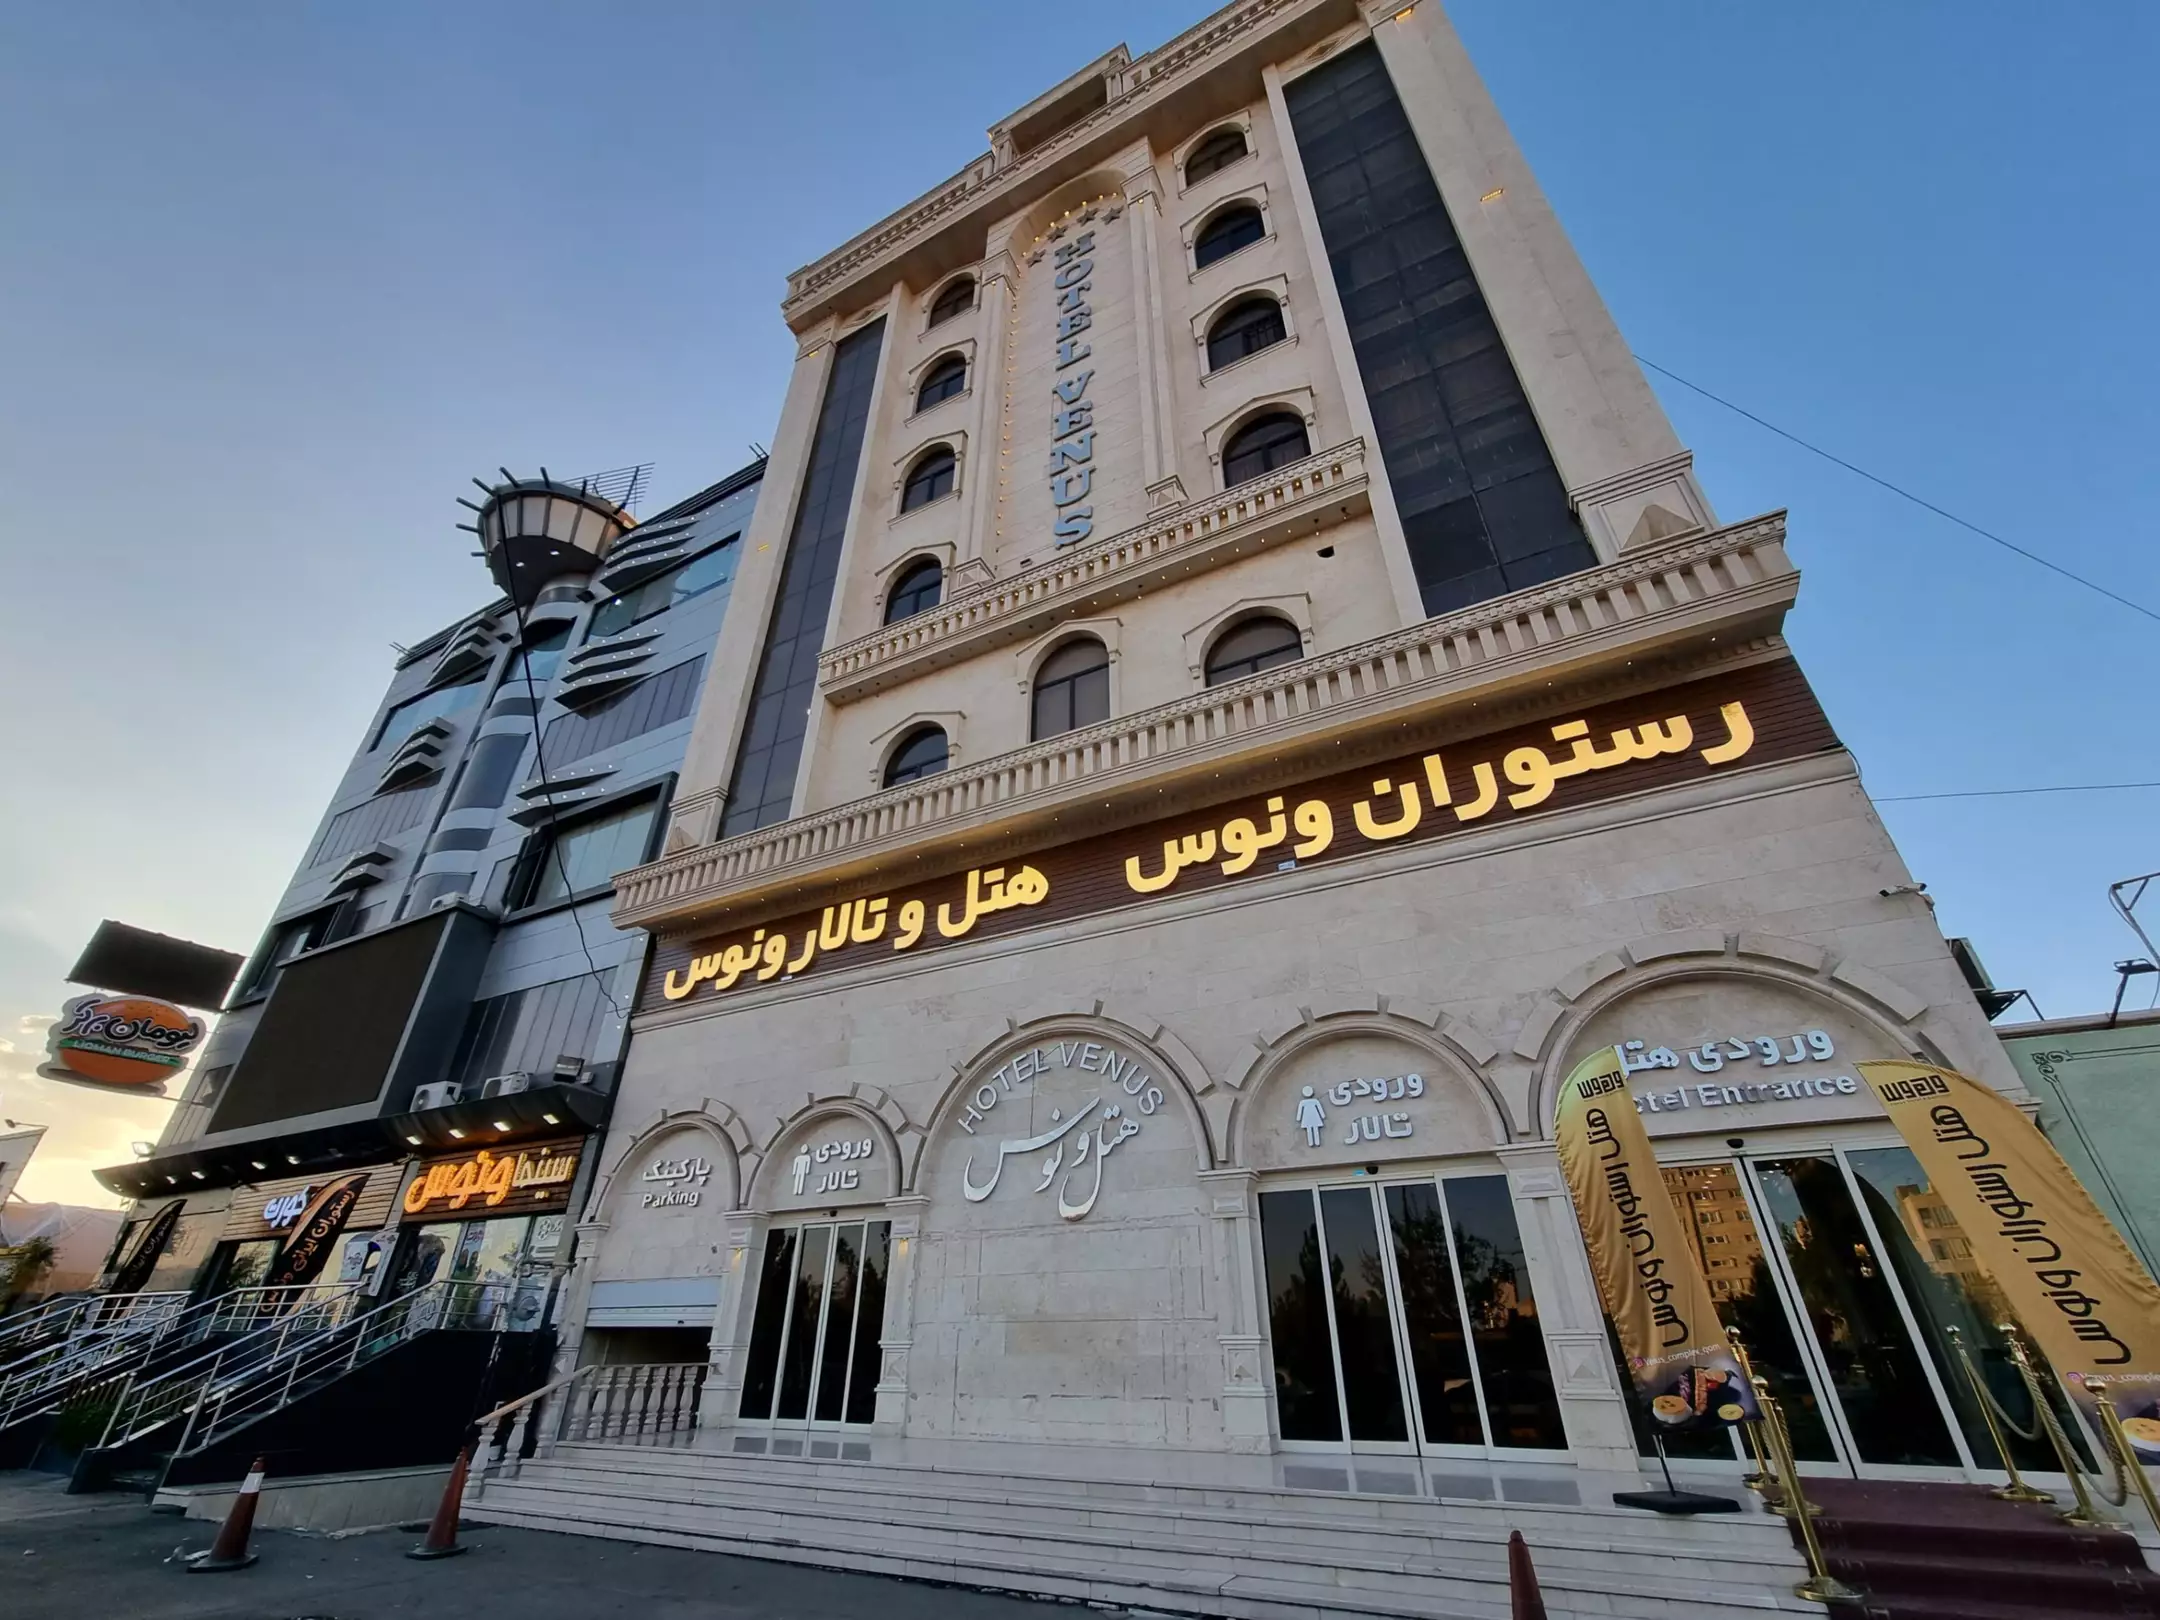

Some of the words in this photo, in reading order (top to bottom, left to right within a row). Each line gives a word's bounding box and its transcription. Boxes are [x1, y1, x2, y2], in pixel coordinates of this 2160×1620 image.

[1054, 230, 1096, 371] HOTEL
[1050, 369, 1097, 550] VENUS
[1353, 700, 1755, 841] رستوران
[1124, 795, 1334, 894] ونوس
[786, 897, 889, 973] تالار
[893, 899, 926, 951] و
[936, 864, 1050, 938] هتل
[663, 928, 787, 1002] ونوس
[957, 1048, 1052, 1135] HOTEL
[1059, 1041, 1165, 1116] VENUS
[1688, 1029, 1835, 1073] ورودی
[1328, 1073, 1424, 1107] ورودی
[1633, 1086, 1690, 1114] otel
[1696, 1075, 1858, 1107] Entrance
[814, 1138, 873, 1163] ورودی
[1058, 1104, 1140, 1222] هتل
[1344, 1111, 1413, 1146] تالار
[403, 1150, 515, 1214] ونوس
[641, 1191, 700, 1208] Parking
[642, 1157, 711, 1187] پارکینگ
[815, 1168, 860, 1194] تالار
[1586, 1108, 1621, 1161] هتل
[1604, 1162, 1655, 1258] رستوران
[1638, 1258, 1689, 1348] ونوس
[1930, 1105, 1990, 1160] هتل
[1965, 1163, 2062, 1264] رستوران
[2035, 1269, 2132, 1365] ونوس
